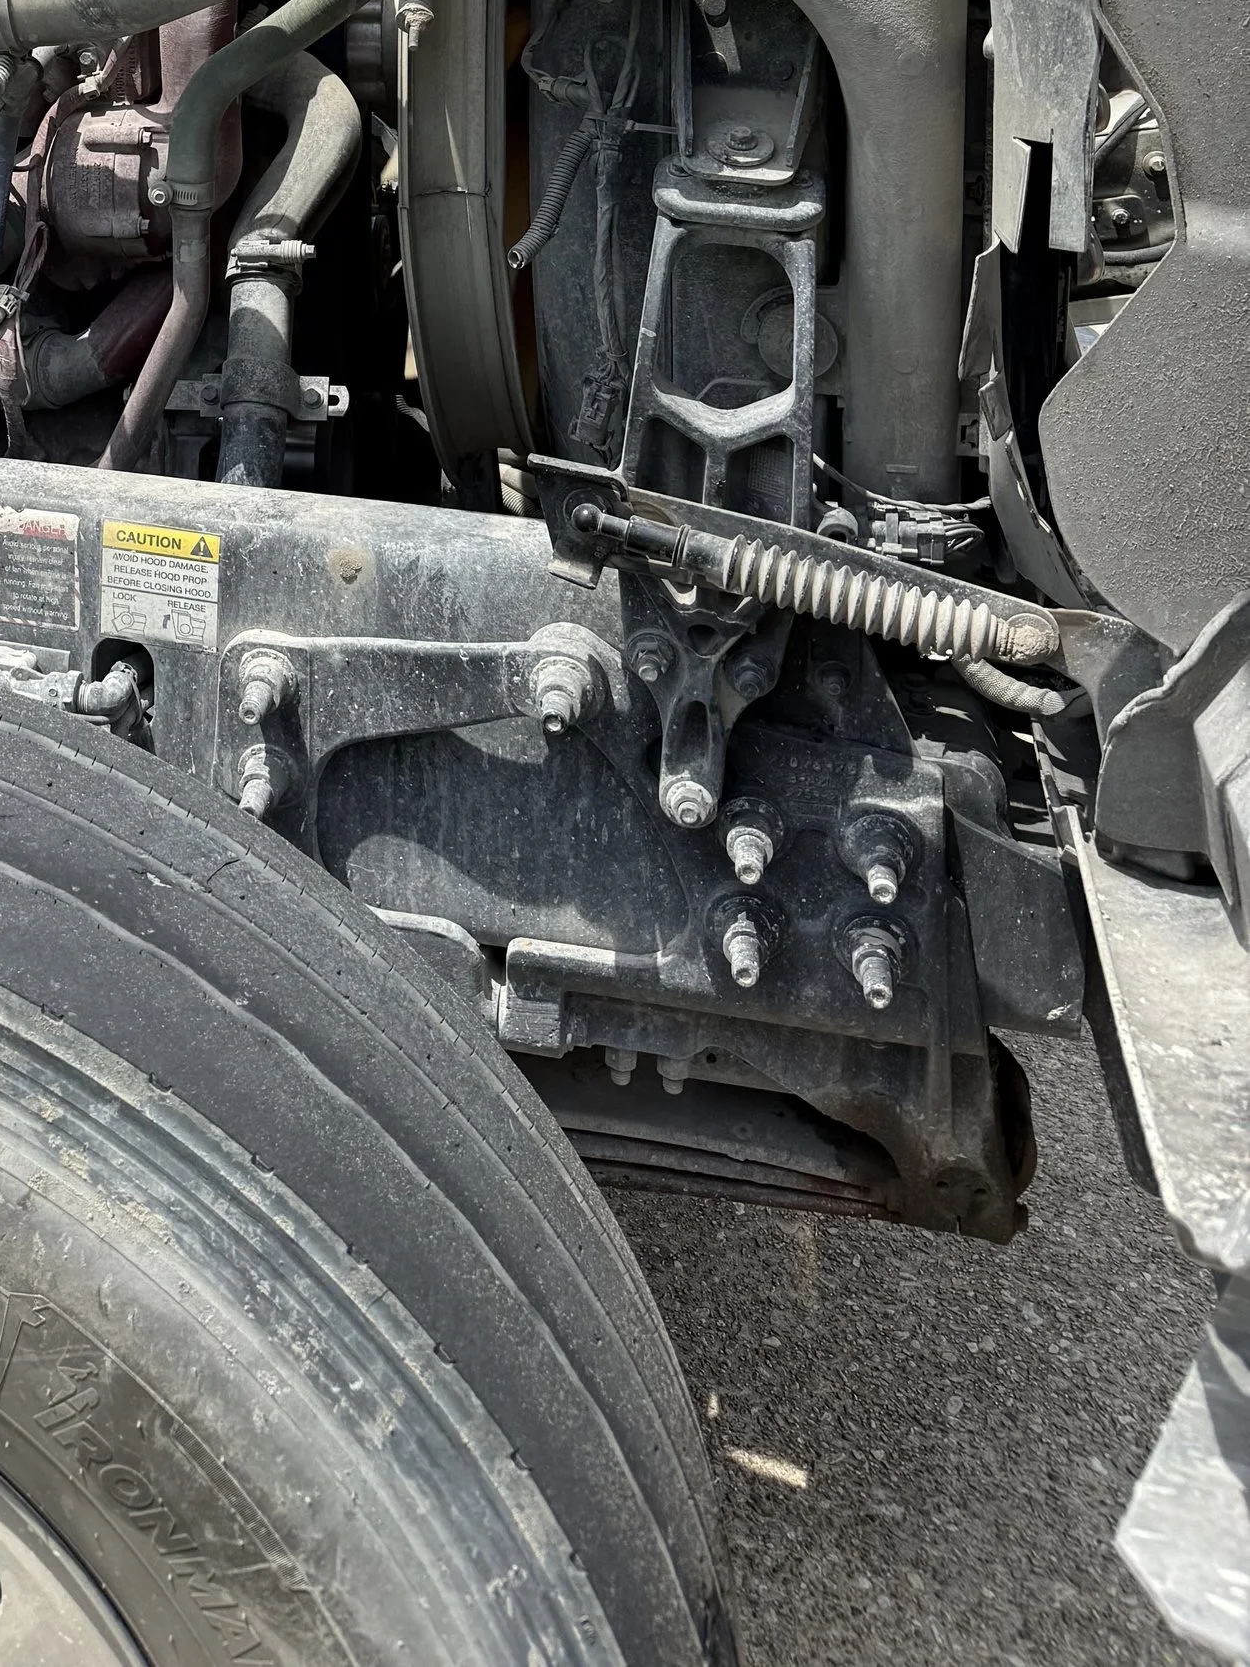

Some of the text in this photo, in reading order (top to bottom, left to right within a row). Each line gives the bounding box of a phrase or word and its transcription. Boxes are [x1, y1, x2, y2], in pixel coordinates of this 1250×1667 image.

[116, 530, 182, 550] CAUTION
[112, 553, 139, 563] AVOID
[140, 557, 167, 566] HOOD
[114, 565, 208, 585] RELEASE HOOD PROP
[107, 575, 213, 599] BEFORE CLOSING HOOD.
[112, 591, 137, 602] LOCK
[167, 599, 207, 613] RELEASE
[34, 1390, 276, 1667] IRONMA
